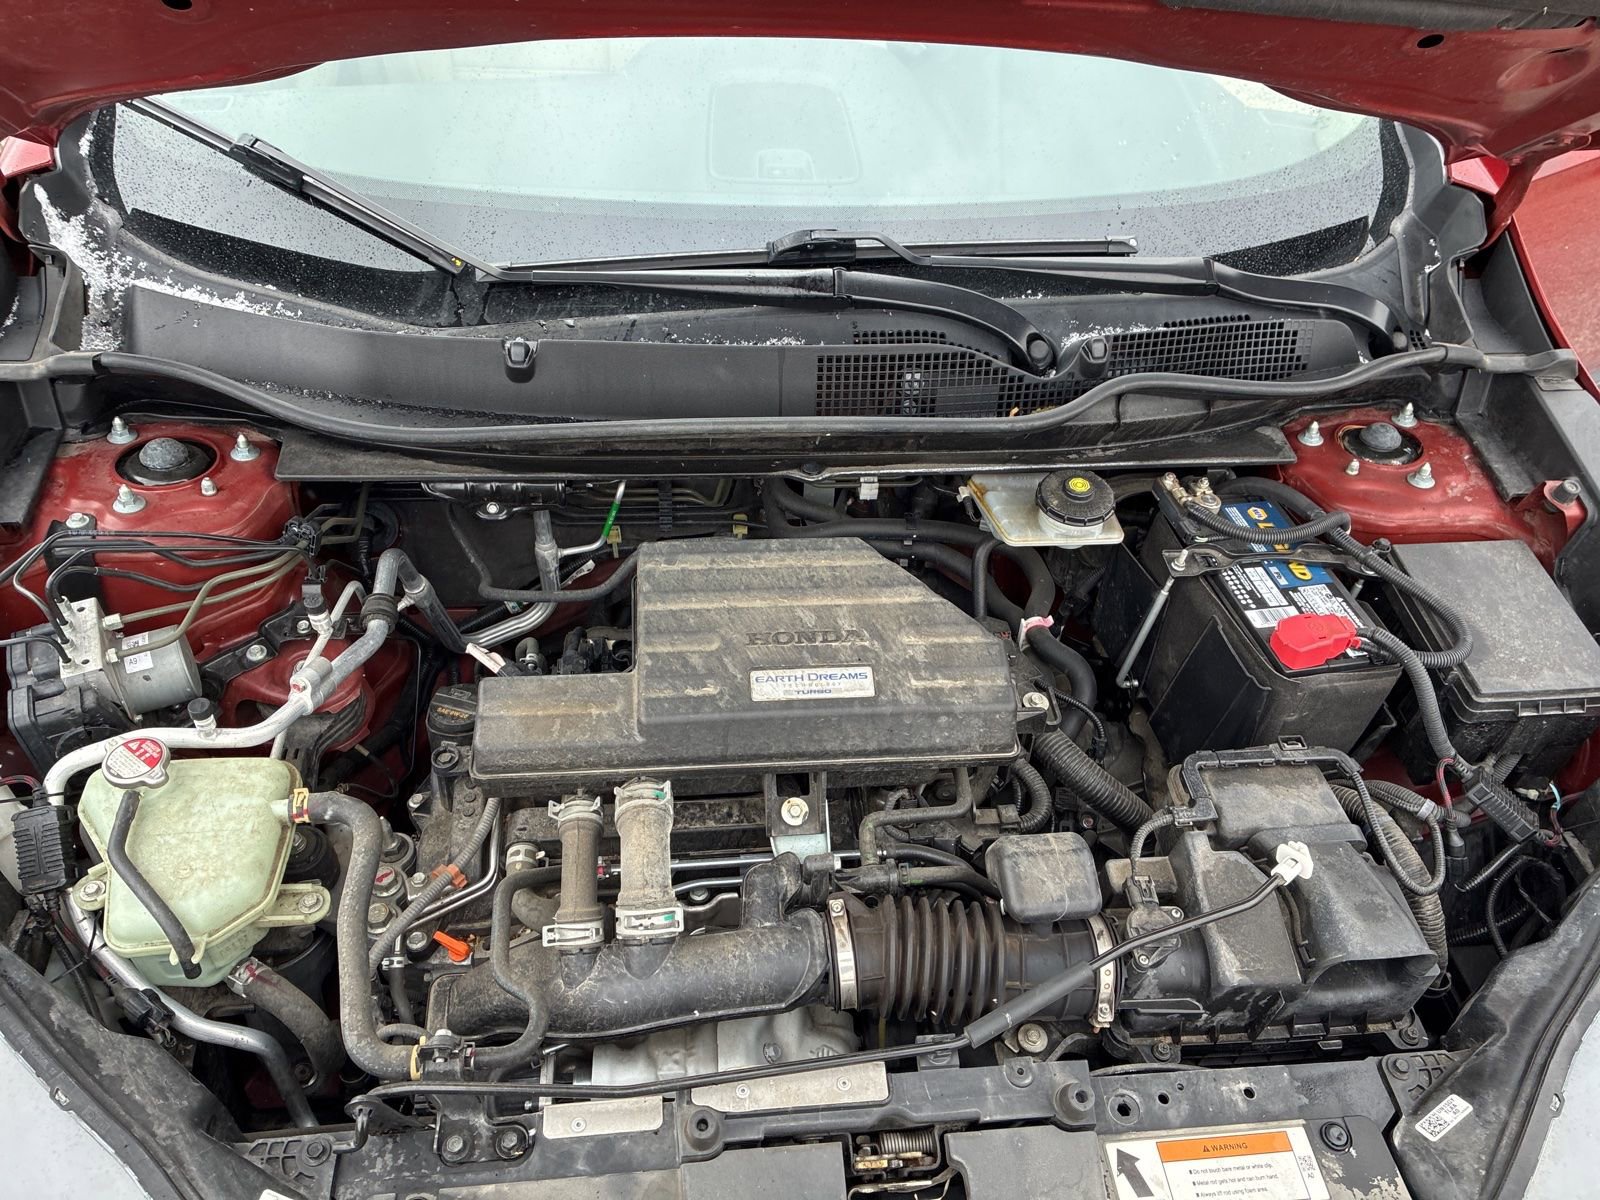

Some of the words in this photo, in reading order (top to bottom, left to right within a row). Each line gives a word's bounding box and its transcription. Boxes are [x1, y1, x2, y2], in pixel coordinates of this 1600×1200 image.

[745, 629, 868, 646] HONDA
[754, 673, 804, 683] EARTH
[807, 671, 868, 681] DREAMS
[1210, 1142, 1248, 1152] WARNING
